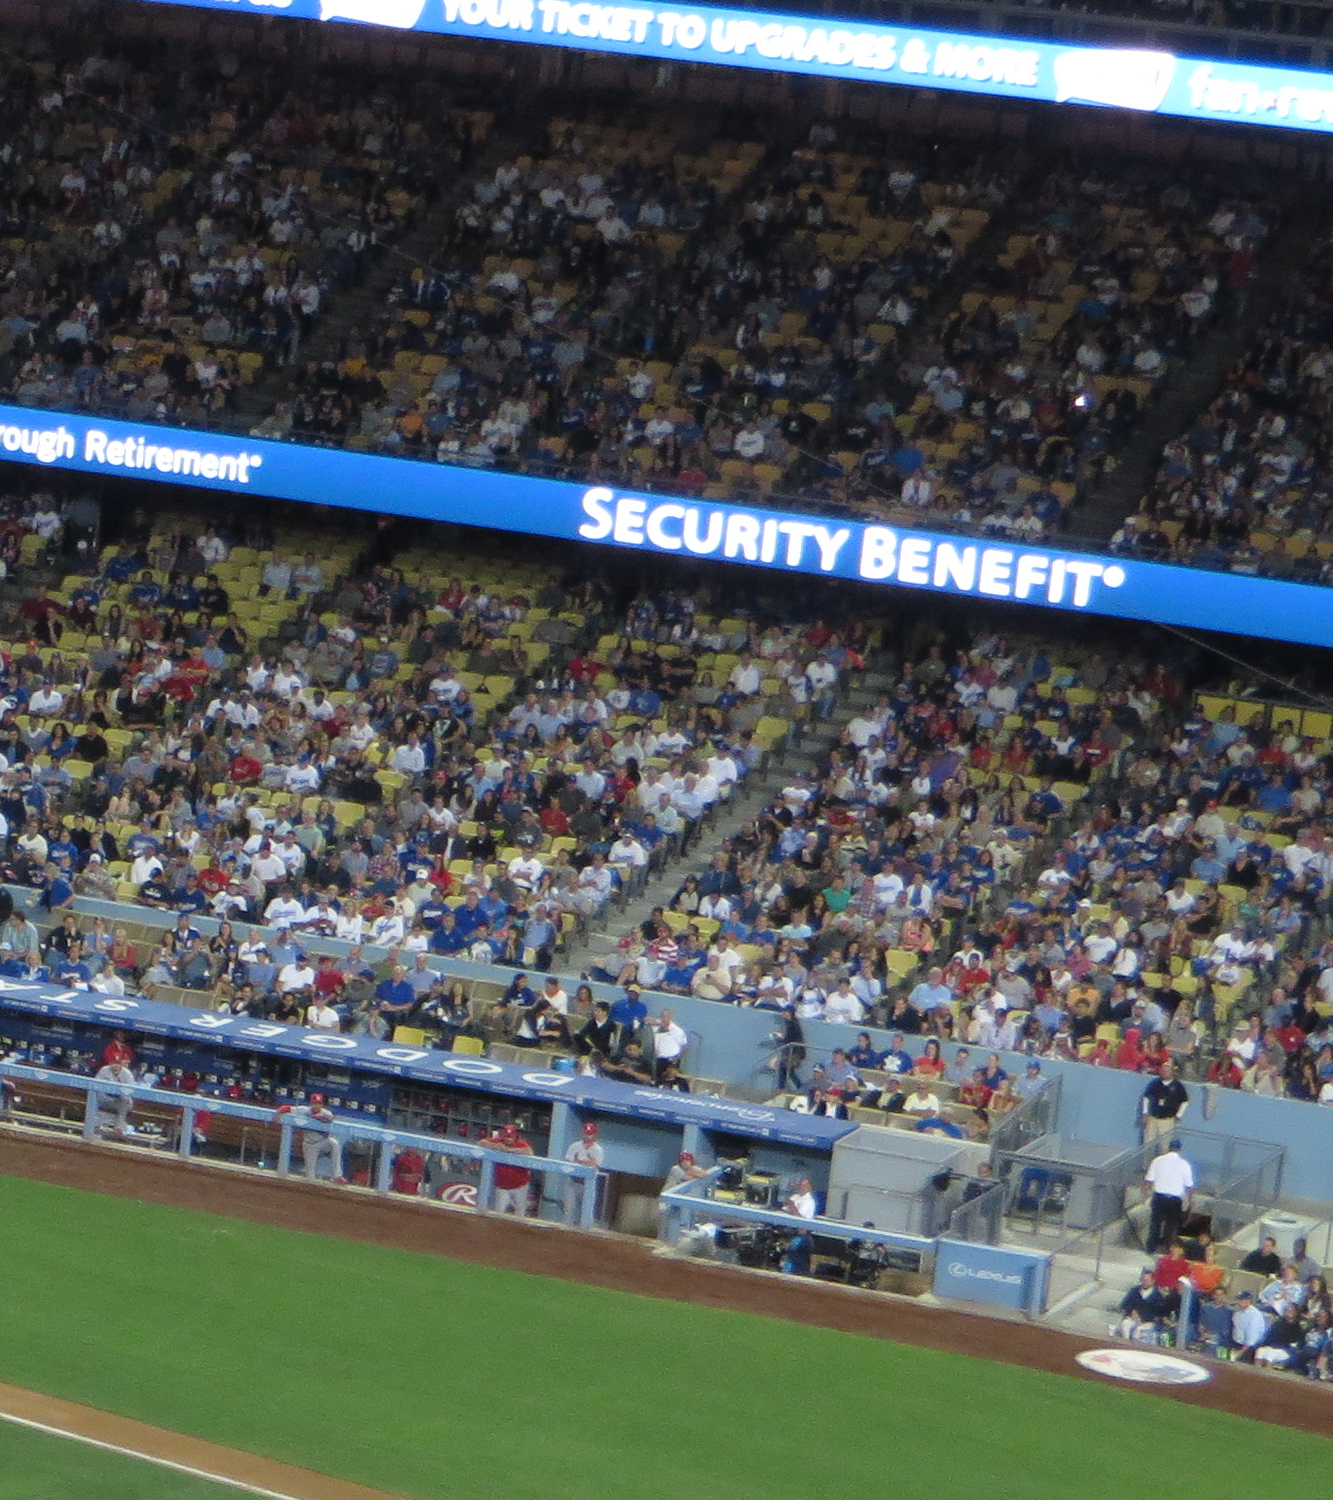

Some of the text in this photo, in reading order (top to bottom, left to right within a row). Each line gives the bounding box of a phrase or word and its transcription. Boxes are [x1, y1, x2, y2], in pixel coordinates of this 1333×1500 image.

[538, 0, 654, 43] TICKET
[656, 12, 708, 49] TO
[710, 18, 895, 72] UPGRADES
[898, 40, 930, 74] &
[933, 42, 1041, 86] MORE
[580, 488, 849, 571] SECURITY
[189, 1012, 575, 1088] DODGER
